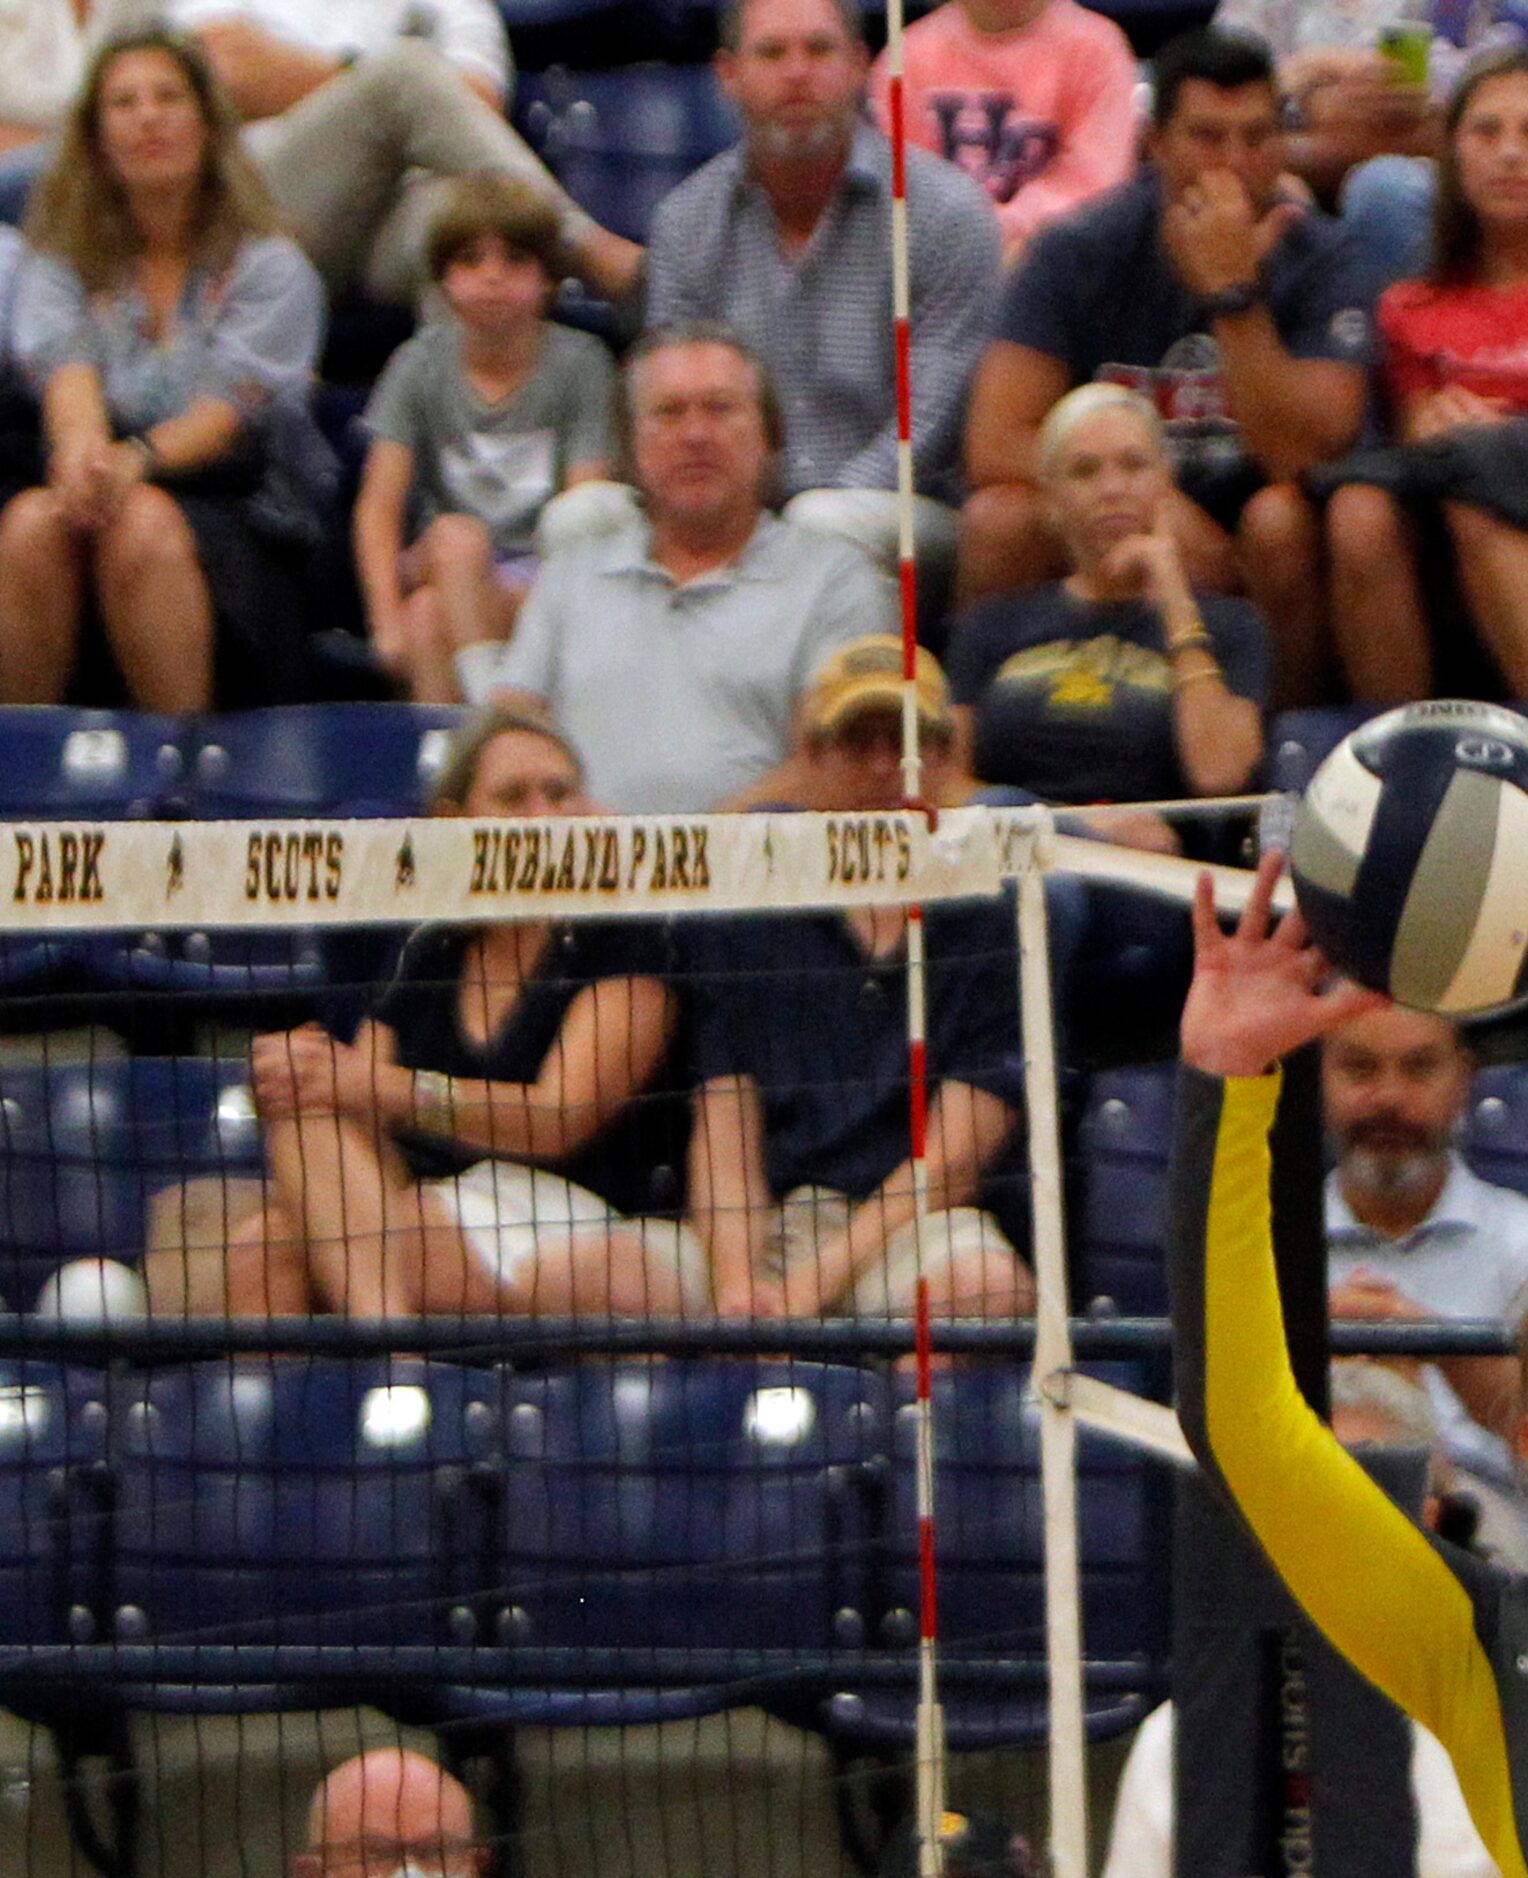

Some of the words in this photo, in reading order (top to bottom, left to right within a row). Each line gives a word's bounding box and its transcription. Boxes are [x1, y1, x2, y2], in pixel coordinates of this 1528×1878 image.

[13, 829, 105, 902] PARK
[245, 830, 344, 901] SCOTS
[626, 824, 710, 890] PARK
